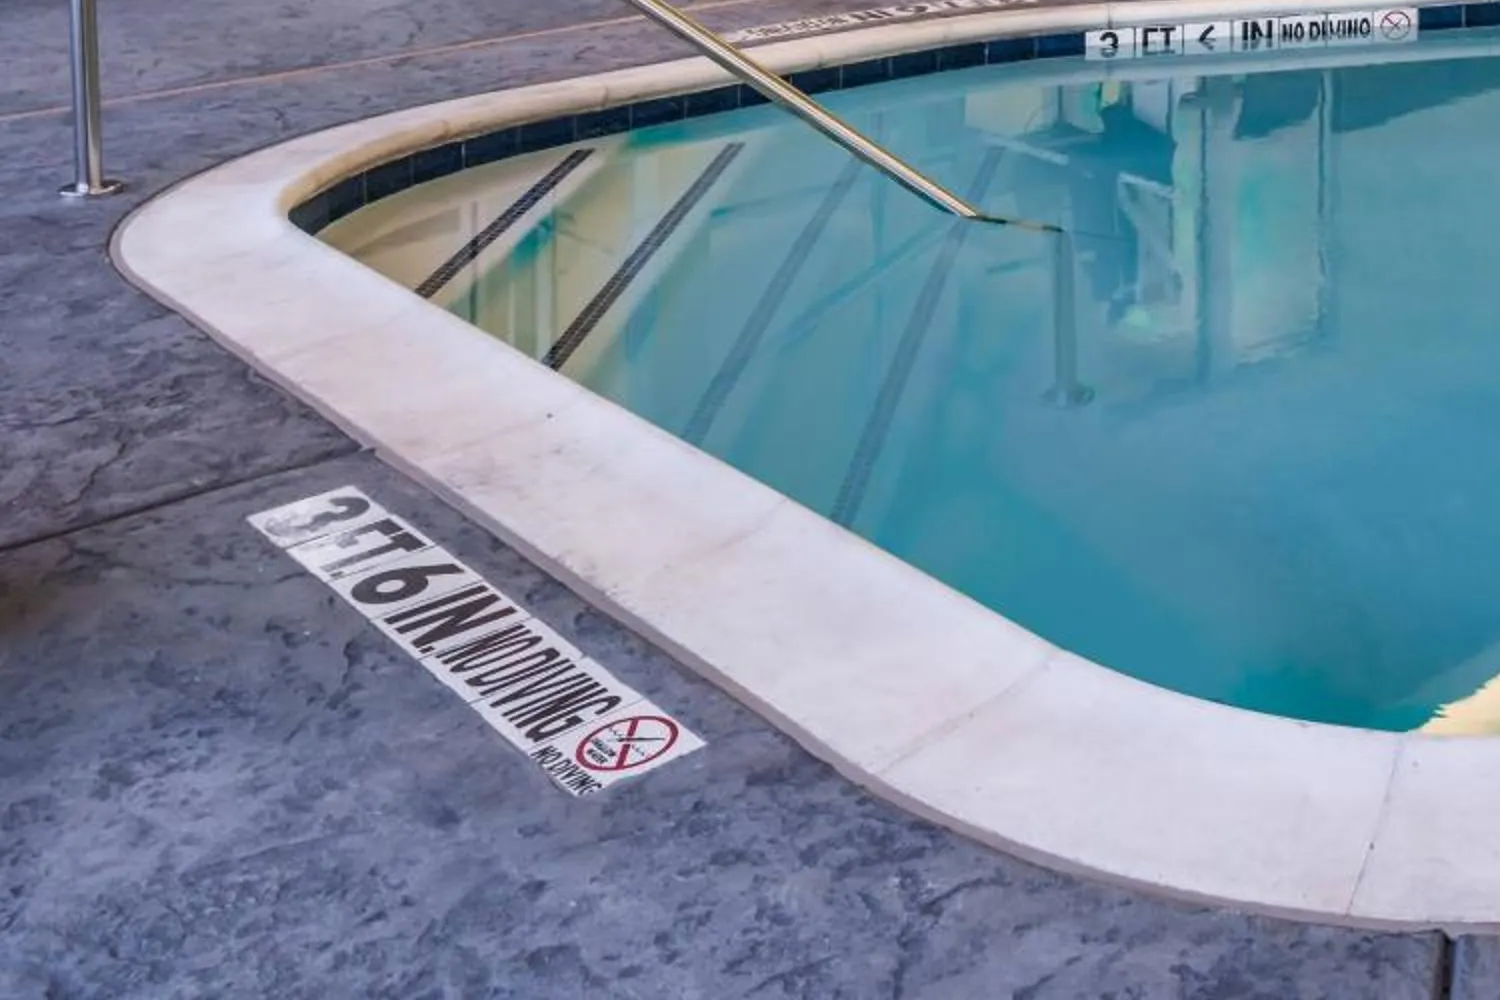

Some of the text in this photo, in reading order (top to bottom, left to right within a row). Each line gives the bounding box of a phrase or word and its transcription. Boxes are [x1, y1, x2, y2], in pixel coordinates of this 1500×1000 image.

[1242, 19, 1273, 44] IN
[351, 563, 466, 604] 6
[434, 624, 543, 672] NO
[465, 647, 622, 743] DIVING
